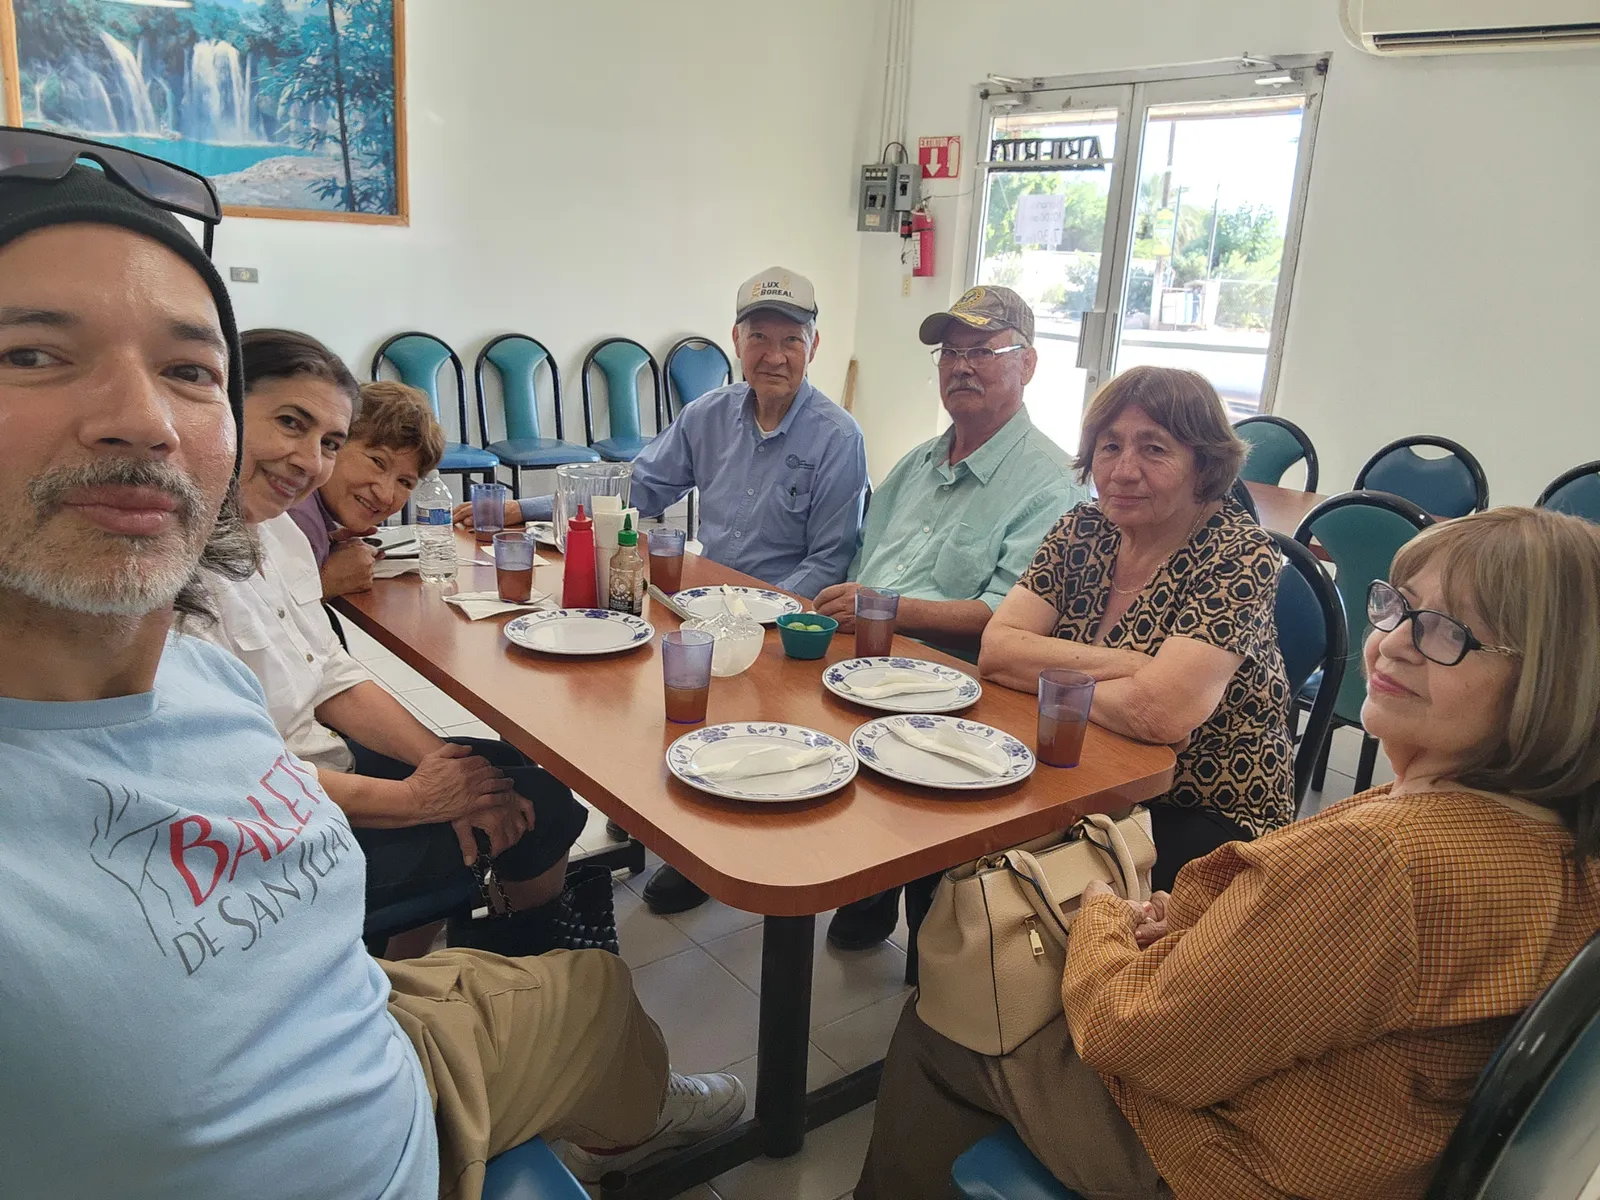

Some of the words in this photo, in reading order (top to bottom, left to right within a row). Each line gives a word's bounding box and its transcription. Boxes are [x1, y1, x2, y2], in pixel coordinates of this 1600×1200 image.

[762, 281, 780, 289] LUX
[760, 289, 795, 299] BOREAL
[171, 916, 225, 977] DE
